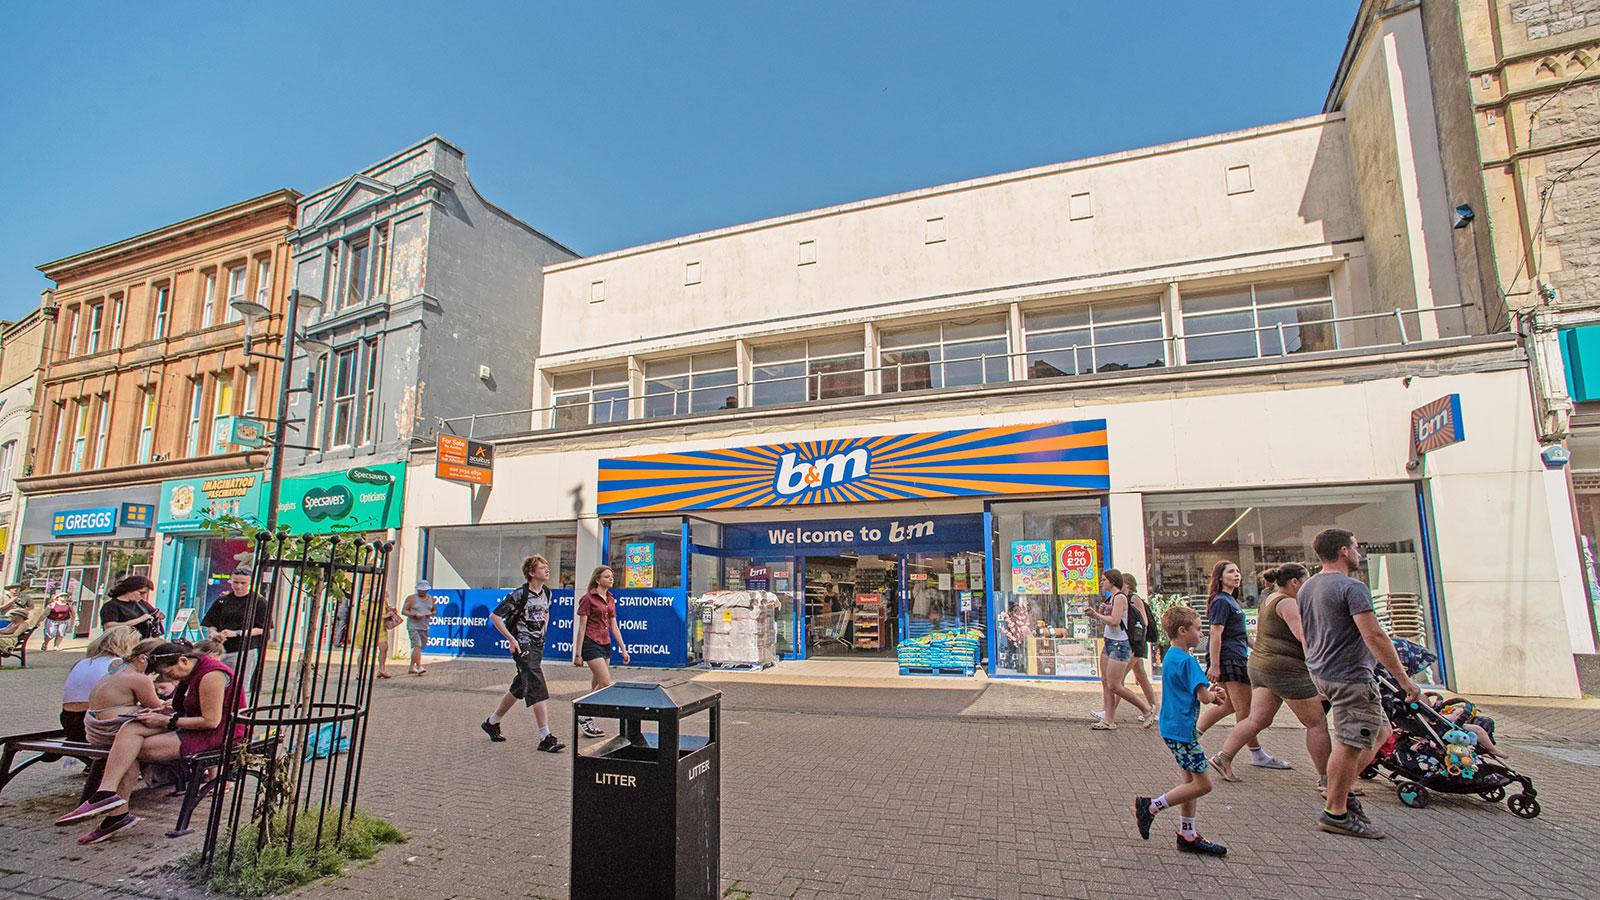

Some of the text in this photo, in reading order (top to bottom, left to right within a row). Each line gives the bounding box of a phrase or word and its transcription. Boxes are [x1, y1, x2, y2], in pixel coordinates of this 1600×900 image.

[353, 470, 388, 481] Specsavers
[776, 448, 868, 495] b&m
[202, 476, 256, 492] IMAGINATION
[305, 494, 345, 510] Specsavers
[360, 492, 386, 504] Opticians
[66, 512, 111, 530] GREGGS
[768, 528, 854, 545] Welcome
[860, 526, 881, 542] to
[1014, 551, 1049, 565] TOYS
[1067, 549, 1086, 557] 2 for
[1067, 557, 1086, 567] £20
[1061, 566, 1095, 580] TOYS
[433, 595, 449, 605] OOD
[619, 596, 674, 606] STATIONERY
[558, 619, 573, 629] DIY
[619, 620, 648, 630] HOME
[426, 637, 474, 648] SOFT DRINKS
[689, 760, 710, 780] LITTER
[595, 773, 637, 788] LITTER
[1182, 822, 1193, 831] 21
